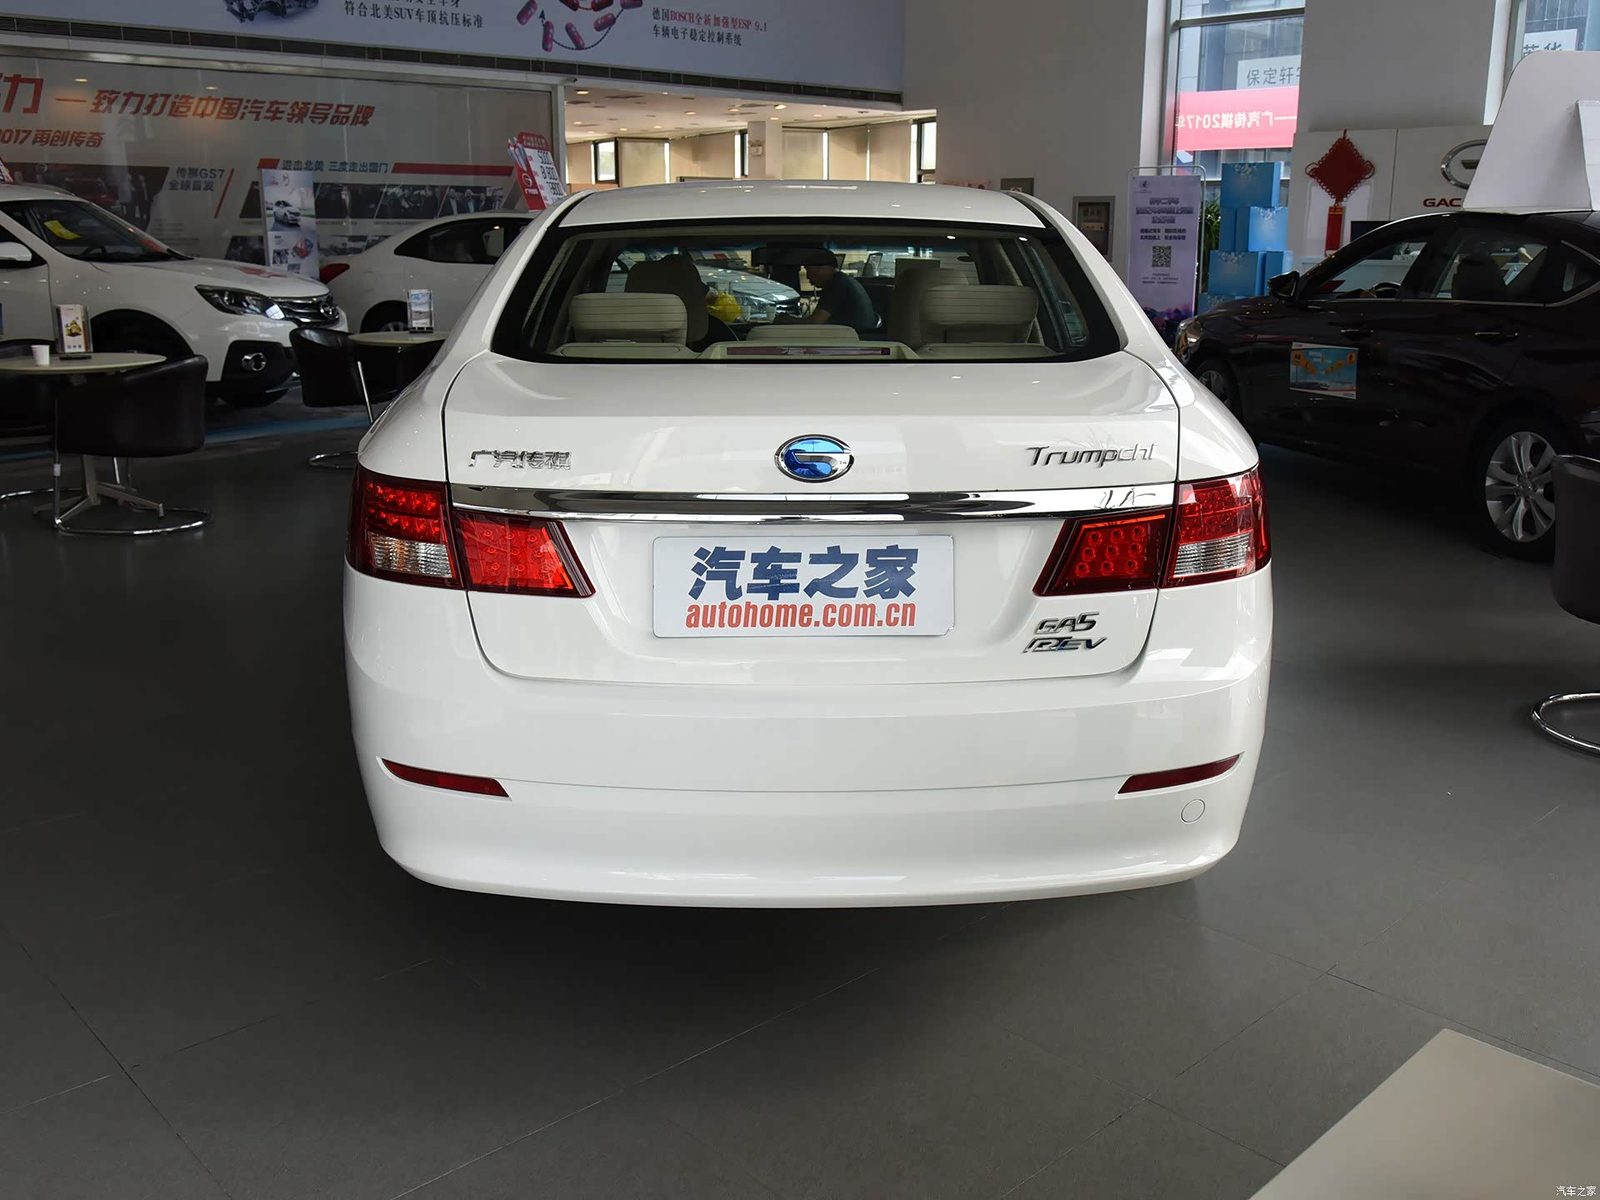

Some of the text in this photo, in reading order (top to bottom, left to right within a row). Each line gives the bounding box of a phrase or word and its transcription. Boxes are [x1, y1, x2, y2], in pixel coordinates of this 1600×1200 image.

[344, 1, 483, 29] 符合北美SUV车顶抗压标准
[652, 23, 742, 46] 车辆电子稳定控制系统
[1423, 198, 1462, 208] GAC
[1026, 443, 1157, 468] Trumpchi
[688, 544, 919, 601] 汽车之家
[685, 600, 917, 629] autohome.com.cn
[1034, 612, 1100, 635] GA5
[1022, 636, 1107, 654] REV
